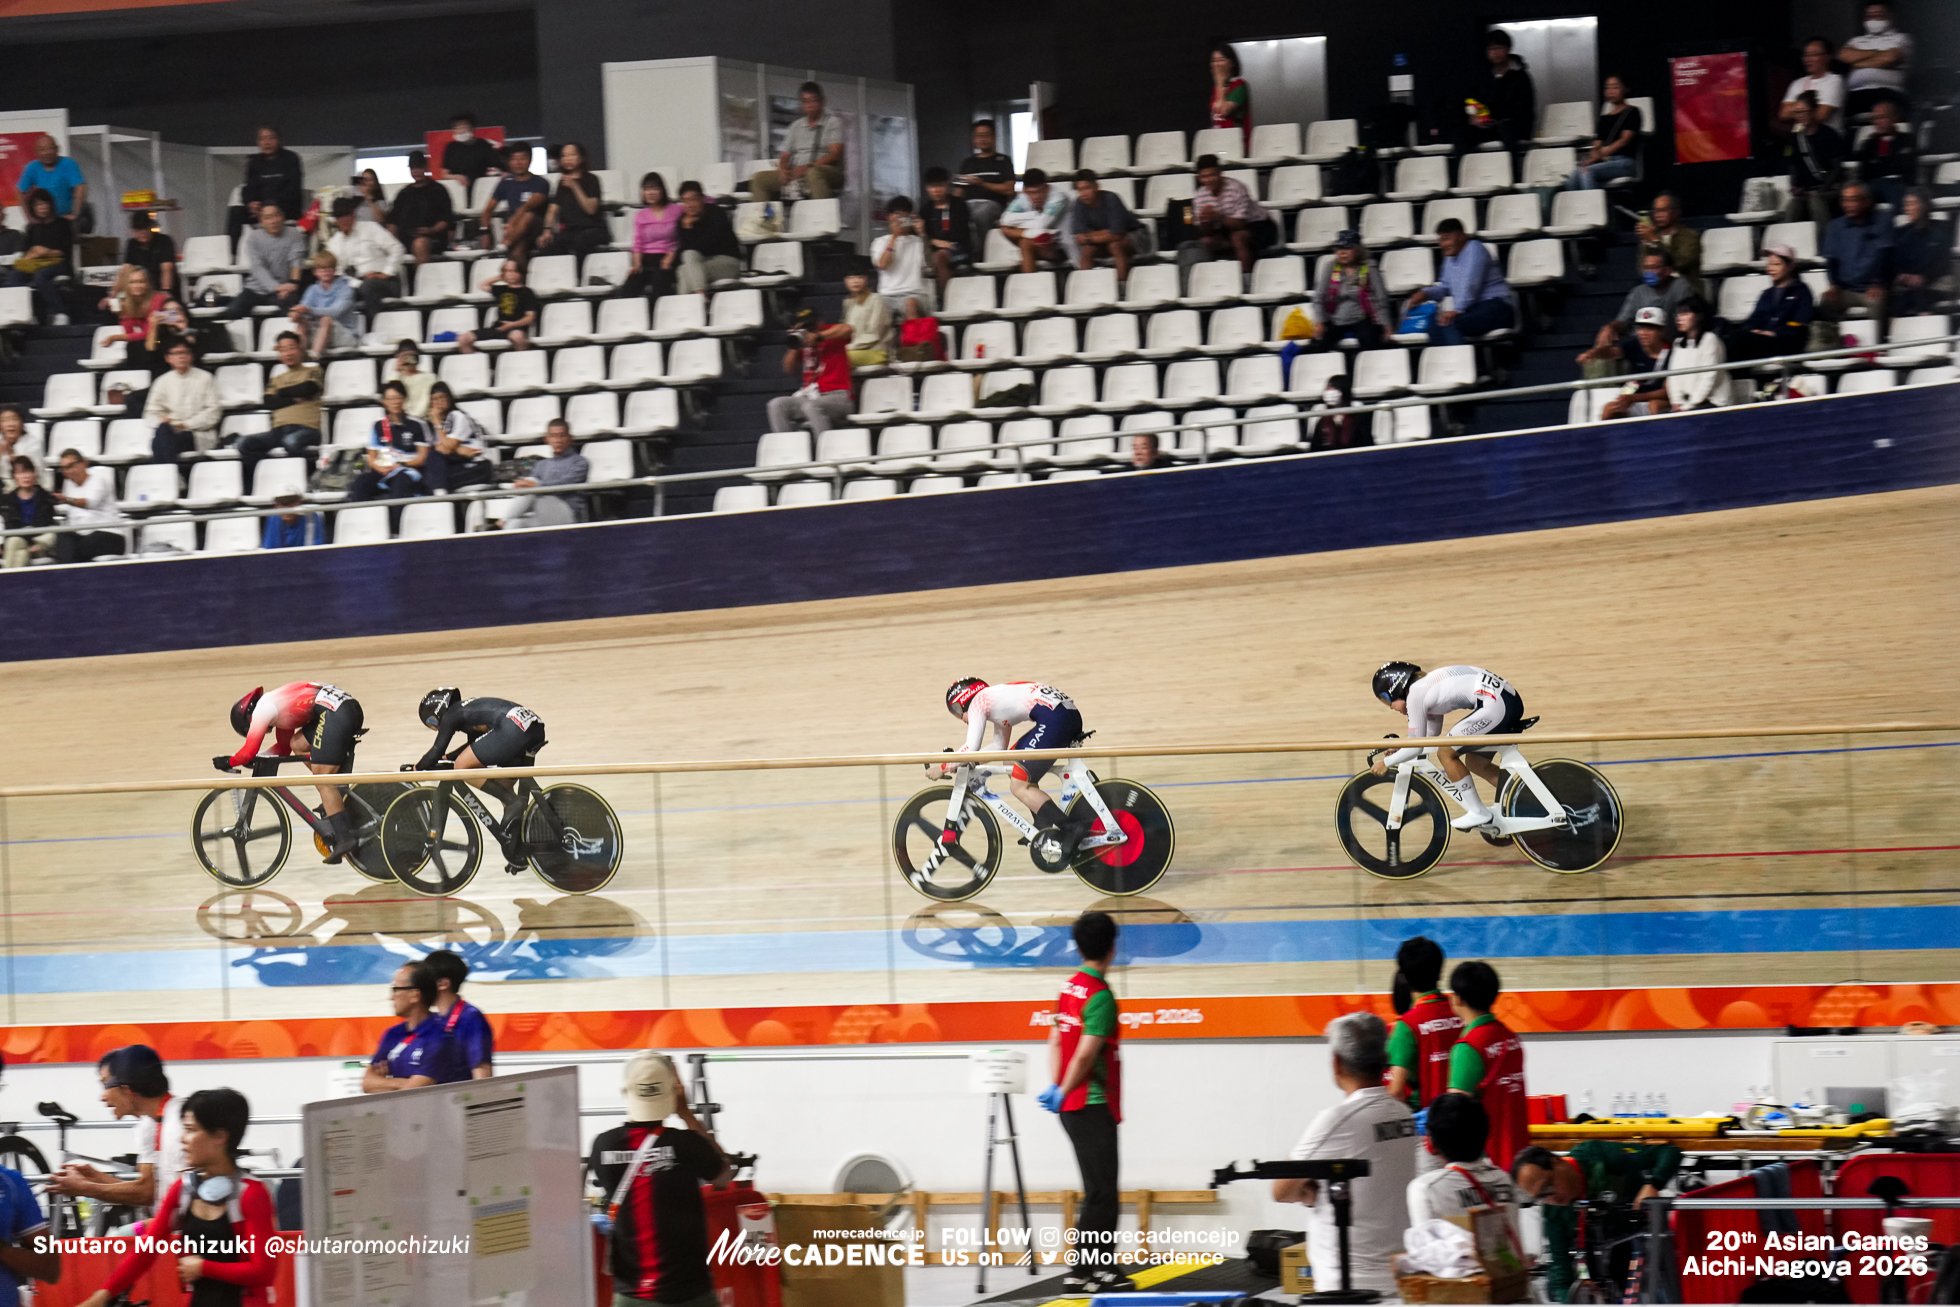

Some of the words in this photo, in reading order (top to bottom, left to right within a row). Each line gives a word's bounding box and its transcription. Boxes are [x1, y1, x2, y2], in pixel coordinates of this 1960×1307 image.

[1481, 672, 1501, 689] 113
[313, 711, 327, 749] CHINA
[1461, 719, 1493, 736] KOREA
[998, 803, 1031, 834] TORAYCA
[1155, 1008, 1204, 1024] 2026
